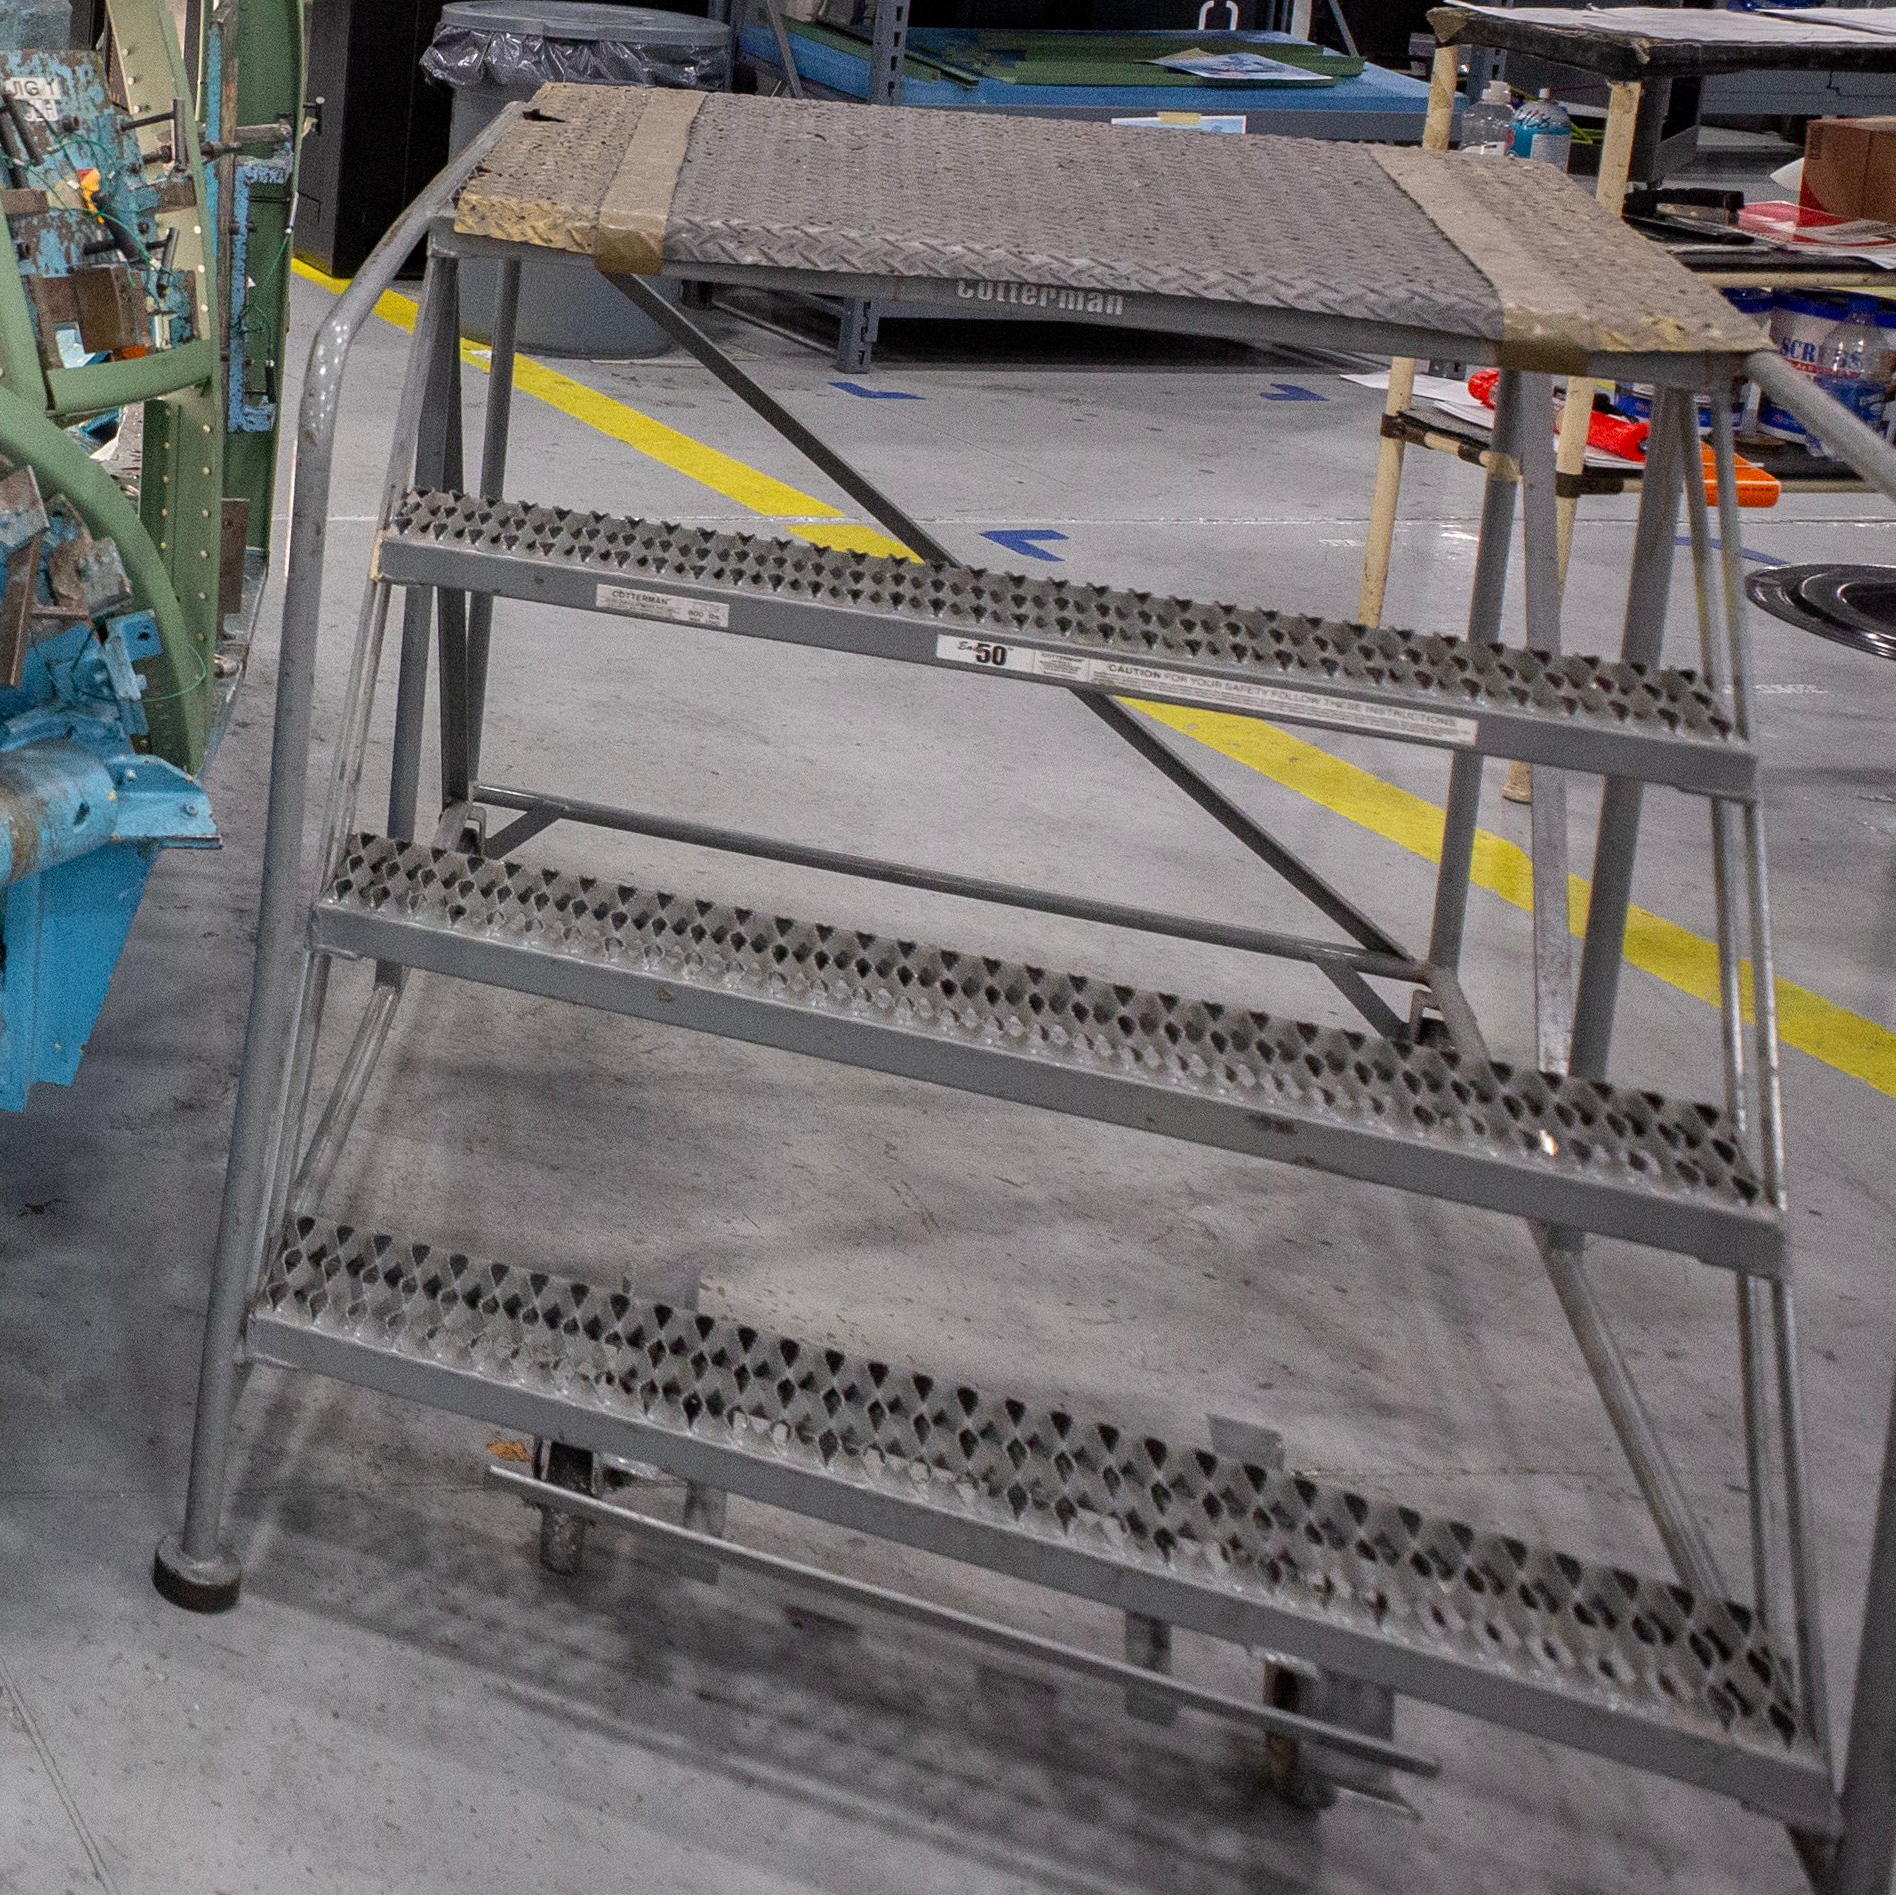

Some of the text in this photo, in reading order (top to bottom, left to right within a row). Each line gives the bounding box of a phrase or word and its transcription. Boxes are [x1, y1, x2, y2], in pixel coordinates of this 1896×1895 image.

[611, 589, 668, 606] COTTERMAN
[975, 642, 1007, 666] 50
[1108, 663, 1161, 679] CAUTION
[1163, 672, 1188, 684] FOR
[1190, 676, 1223, 689] YOUR
[1225, 681, 1269, 697] SAFETY
[1270, 689, 1320, 706] FOLLOW
[1366, 703, 1456, 725] INSTRUCTIONS
